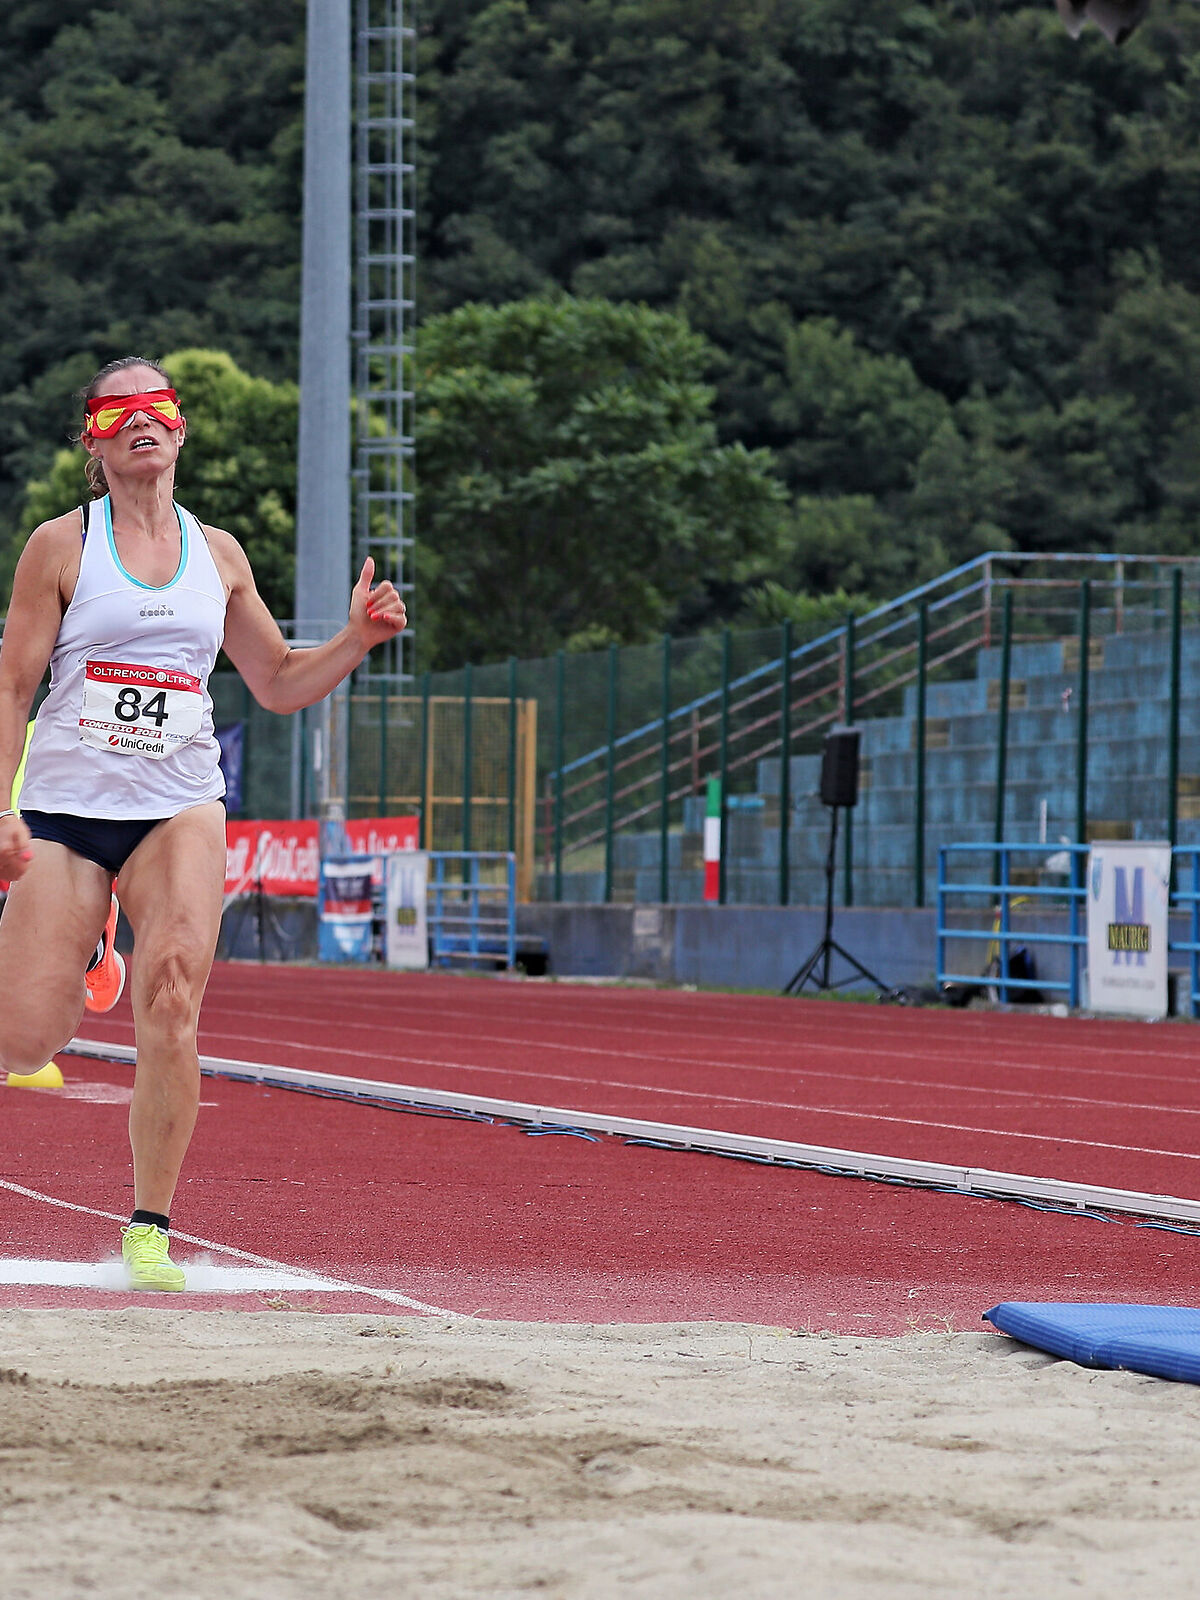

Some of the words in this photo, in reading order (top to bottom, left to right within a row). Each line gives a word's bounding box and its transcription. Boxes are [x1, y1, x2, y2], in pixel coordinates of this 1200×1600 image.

[114, 688, 169, 727] 84
[83, 719, 134, 734] CONCESIO
[134, 727, 161, 738] 2021
[120, 737, 165, 753] UniCredit
